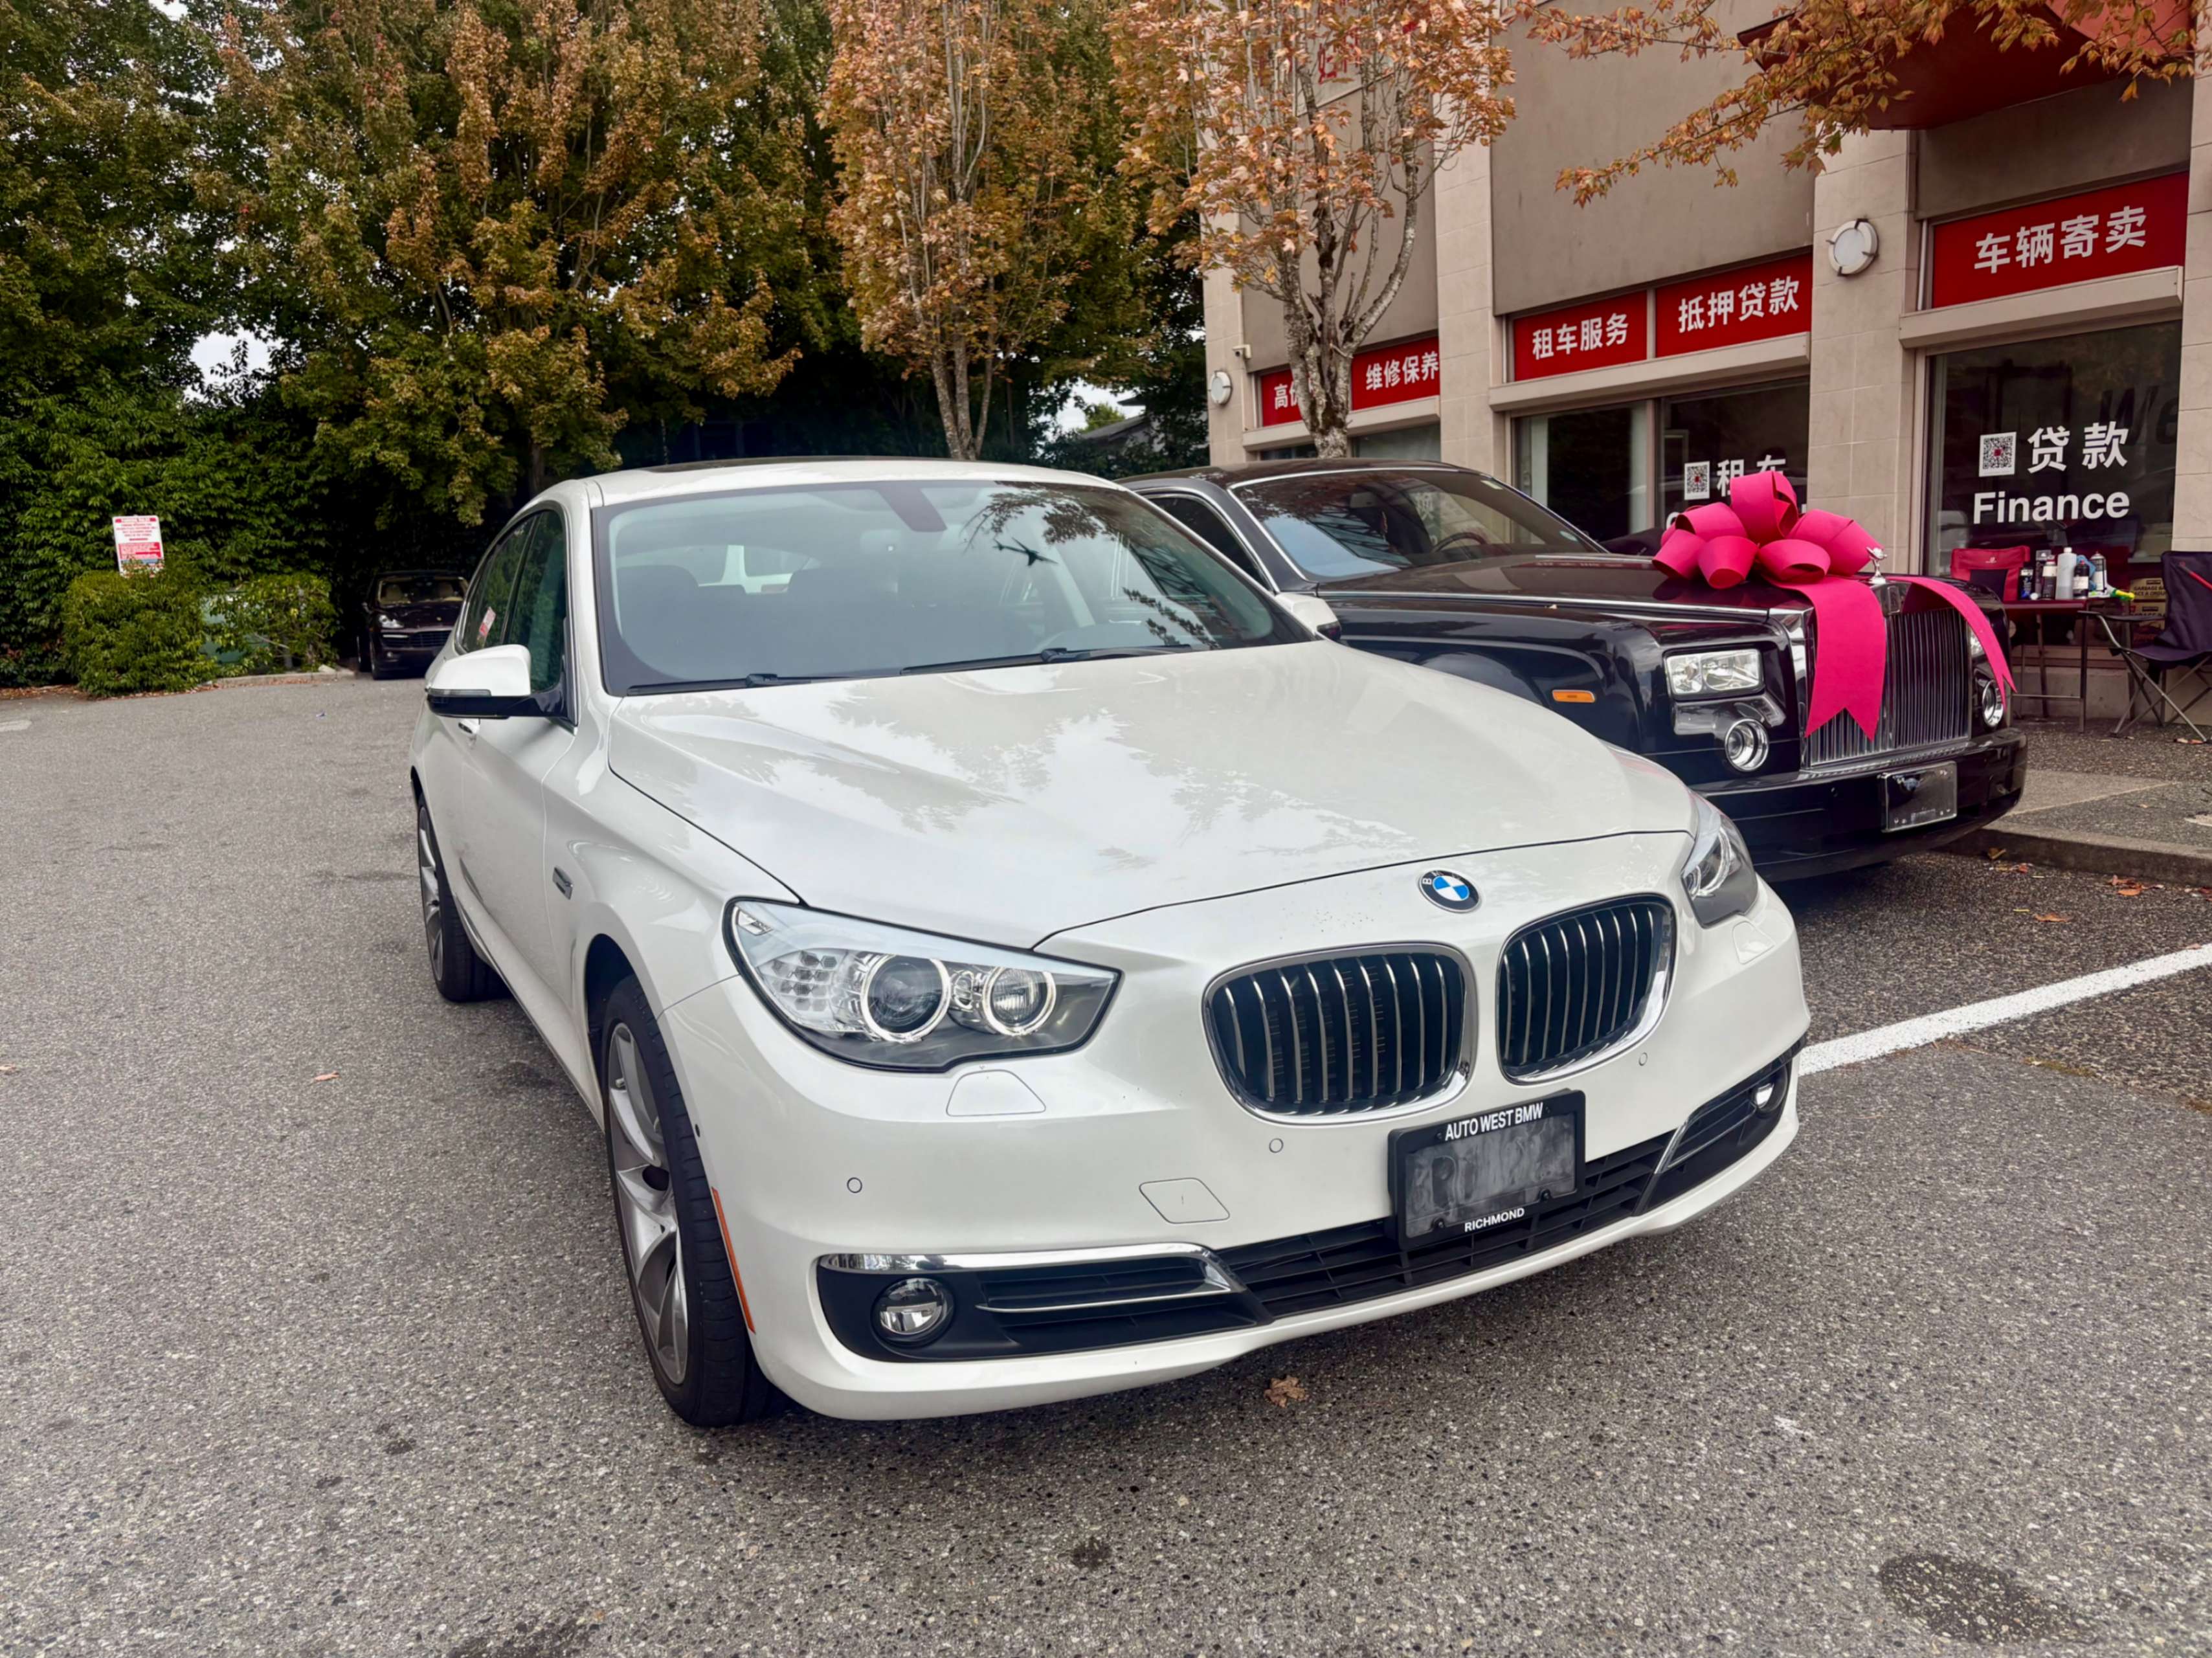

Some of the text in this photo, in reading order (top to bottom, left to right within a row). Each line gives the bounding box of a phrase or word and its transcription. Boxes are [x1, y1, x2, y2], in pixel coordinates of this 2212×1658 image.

[1974, 205, 2147, 274] 车辆寄卖
[1677, 275, 1800, 333] 抵押贷款
[1532, 313, 1629, 360] 租车服务
[1365, 351, 1439, 391] 维修保养
[2028, 421, 2128, 473] 贷款
[1973, 491, 2130, 524] Finance
[1445, 1102, 1543, 1141] AUTO WEST BMW
[1464, 1207, 1525, 1233] RICHMOND
